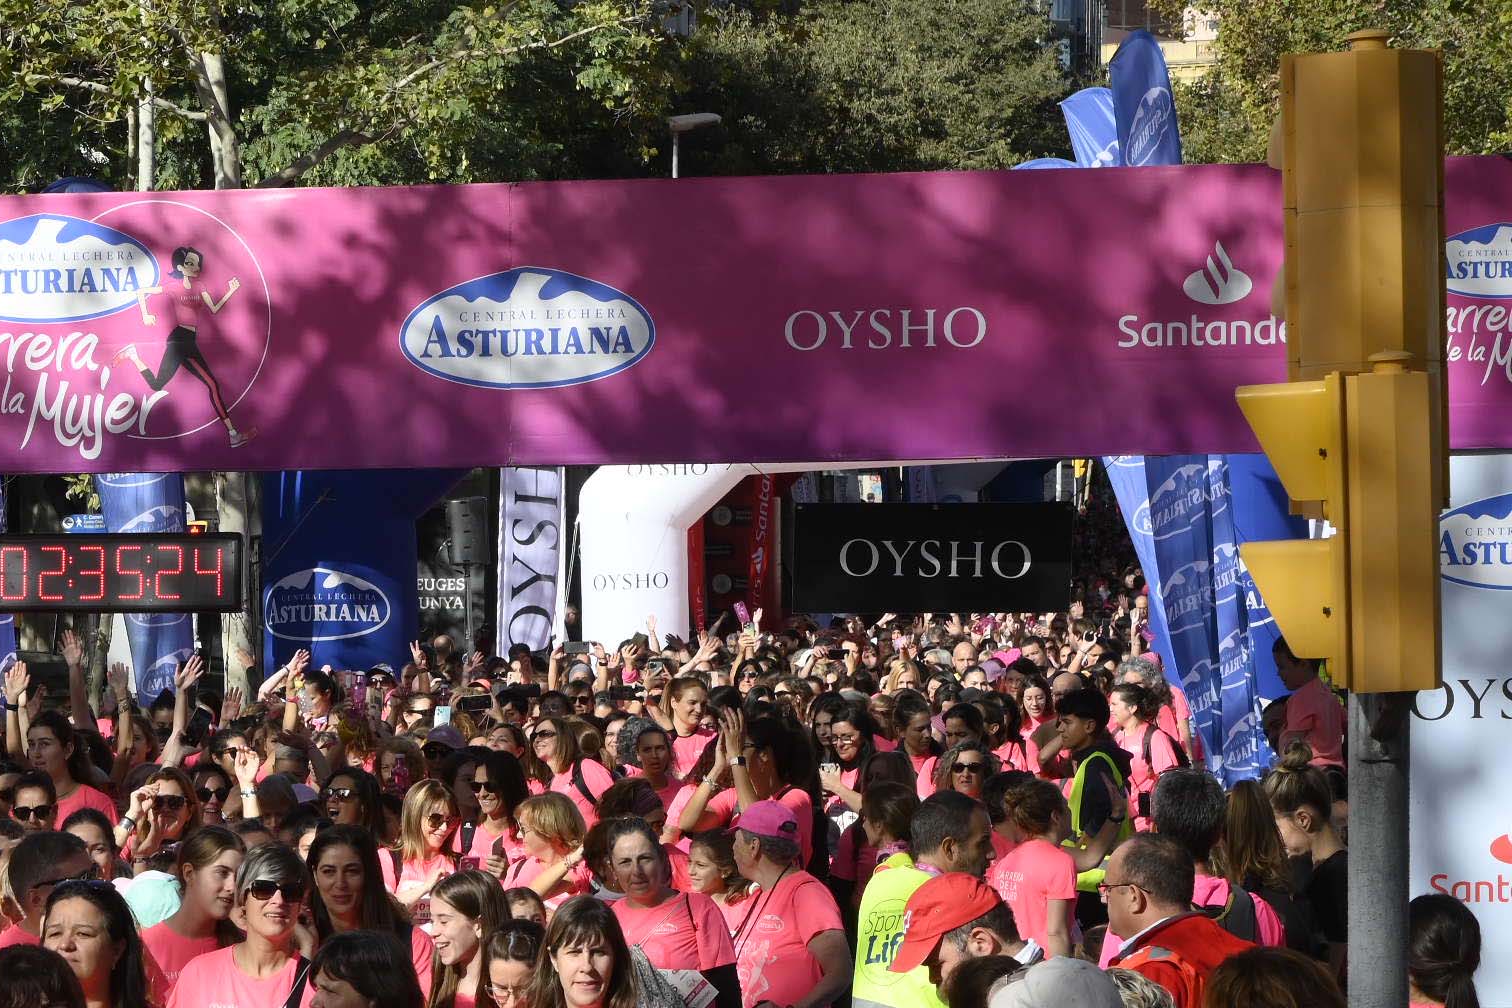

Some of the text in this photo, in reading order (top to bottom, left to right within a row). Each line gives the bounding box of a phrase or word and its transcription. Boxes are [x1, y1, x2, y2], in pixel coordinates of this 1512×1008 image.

[62, 250, 135, 262] LECHERA
[459, 308, 627, 322] CENTRAL LECHERA
[785, 307, 987, 351] OYSHO
[1118, 314, 1287, 348] Santand
[420, 315, 635, 359] ASTURIANA
[1467, 334, 1485, 362] la
[0, 375, 25, 414] la
[20, 366, 169, 460] Mujer
[755, 475, 771, 546] Santa
[1465, 526, 1512, 538] CENTR
[0, 545, 224, 600] 02:35:24
[506, 465, 559, 654] OYSH
[839, 538, 1032, 579] OYSHO
[593, 571, 669, 591] OYSHO
[268, 597, 381, 625] ASTURIANA
[419, 596, 465, 609] UNYA
[1412, 678, 1512, 721] OYS
[865, 910, 904, 936] Spor
[865, 935, 905, 972] Lif
